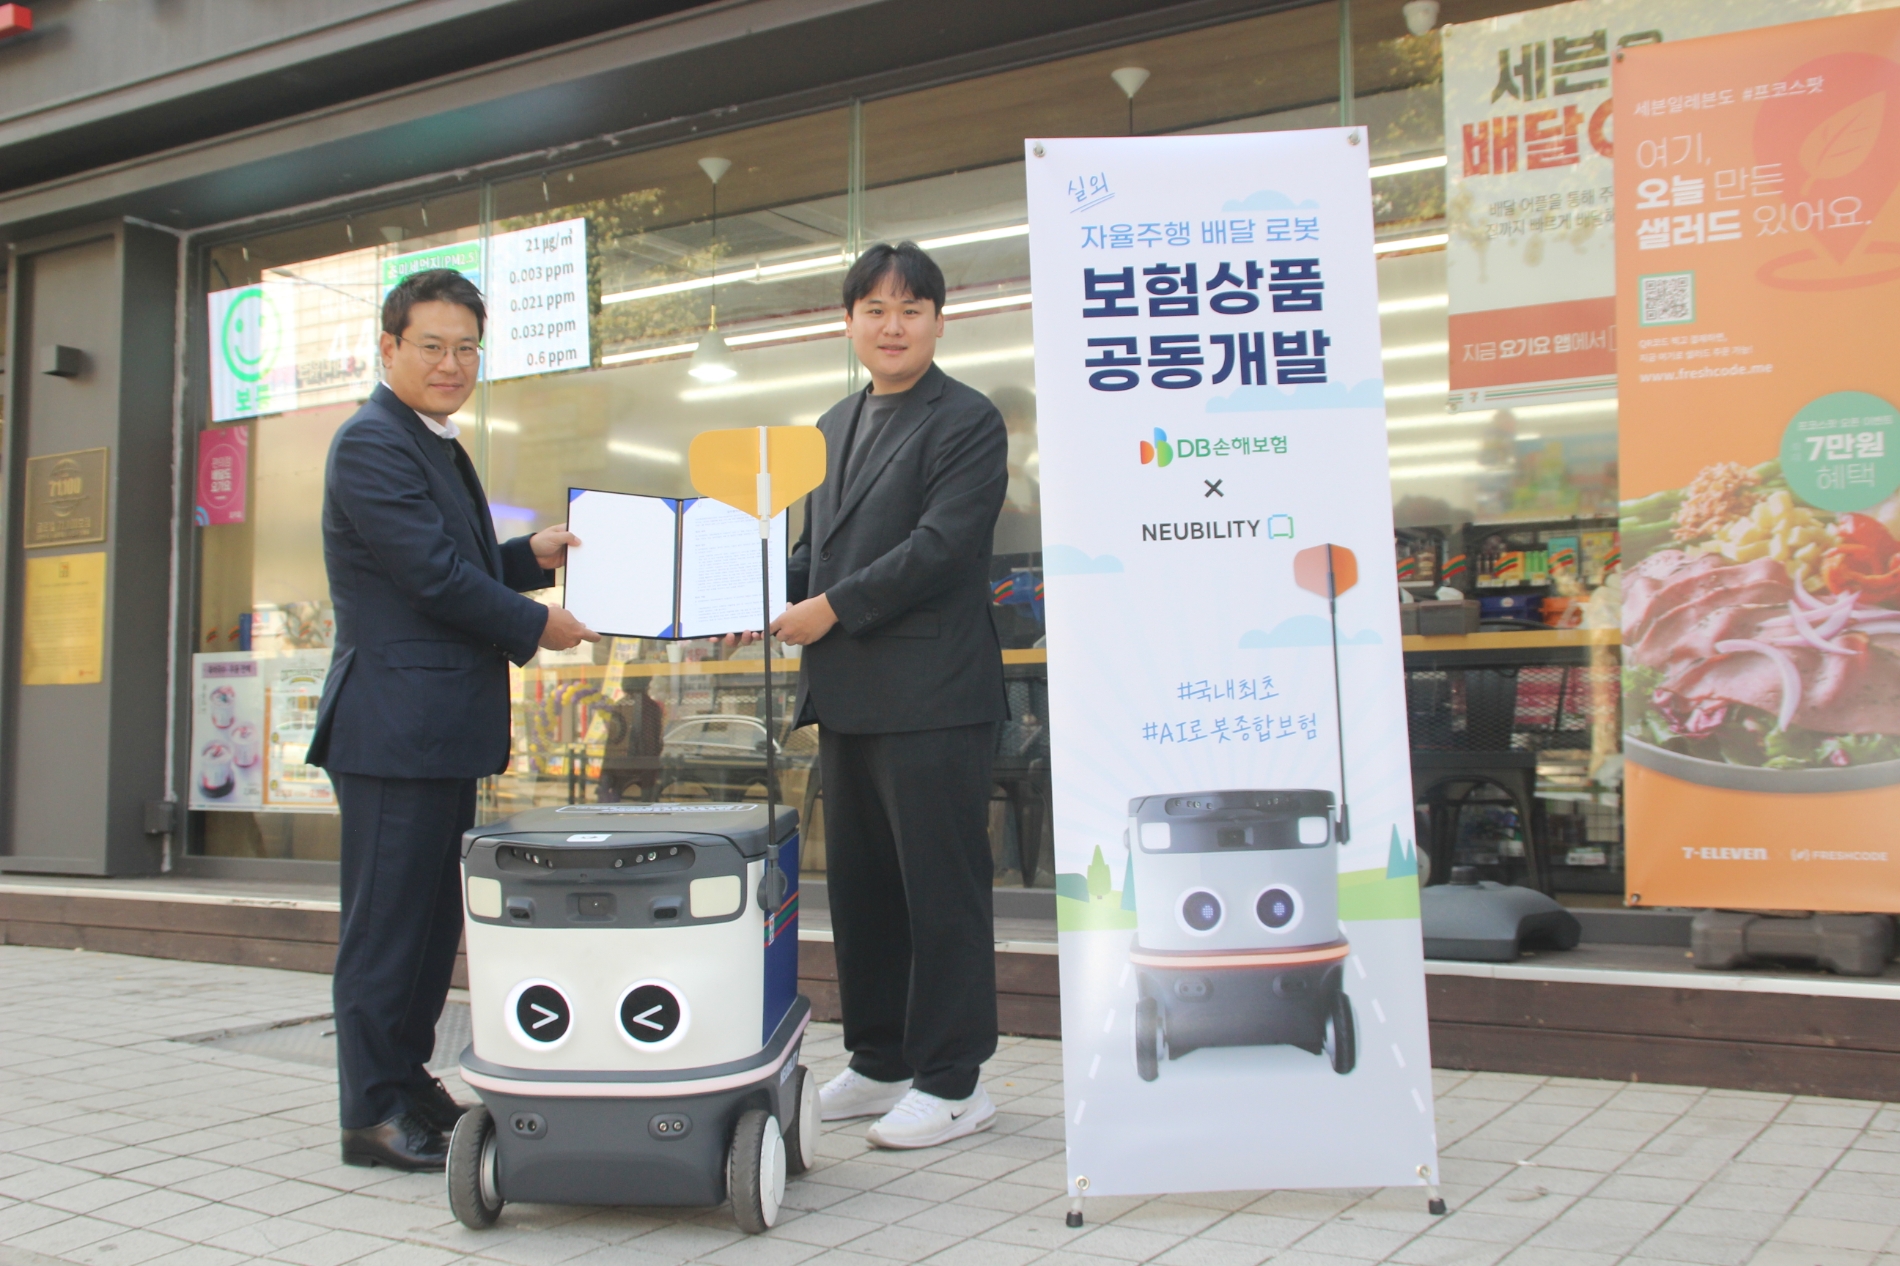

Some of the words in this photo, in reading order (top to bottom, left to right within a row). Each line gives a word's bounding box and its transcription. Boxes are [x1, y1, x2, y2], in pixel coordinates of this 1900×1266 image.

[1633, 89, 1735, 117] 세븐일레븐도
[1635, 132, 1712, 170] 여기,
[1067, 172, 1110, 202] 실외
[1636, 174, 1705, 211] 오늘
[1713, 162, 1785, 201] 만든
[1080, 220, 1191, 249] 자율주행
[1201, 219, 1256, 245] 배달
[1265, 216, 1321, 242] 로봇
[1635, 209, 1743, 250] 샐러드
[1753, 195, 1873, 238] 있어요.
[525, 237, 540, 252] 21
[509, 266, 543, 284] 0.003
[545, 262, 575, 282] ppm
[510, 294, 544, 312] 0.021
[546, 290, 576, 311] ppm
[1082, 258, 1325, 319] 보험상품
[511, 322, 545, 340] 0.032
[547, 319, 577, 339] ppm
[526, 350, 546, 366] 0.6
[548, 347, 578, 368] ppm
[1462, 341, 1497, 362] 지금
[1500, 335, 1551, 359] 요기요
[1553, 329, 1606, 354] 앱에서
[1084, 329, 1332, 392] 공동개발
[1639, 363, 1773, 382] www.freshcode.me
[1177, 436, 1288, 458] DB손해보험
[1805, 431, 1885, 461] 7만원
[1816, 462, 1875, 490] 혜택
[1142, 520, 1260, 541] NEUBILITY
[1177, 675, 1279, 702] #국내최초
[1142, 712, 1318, 744] #AI로봇종합보험
